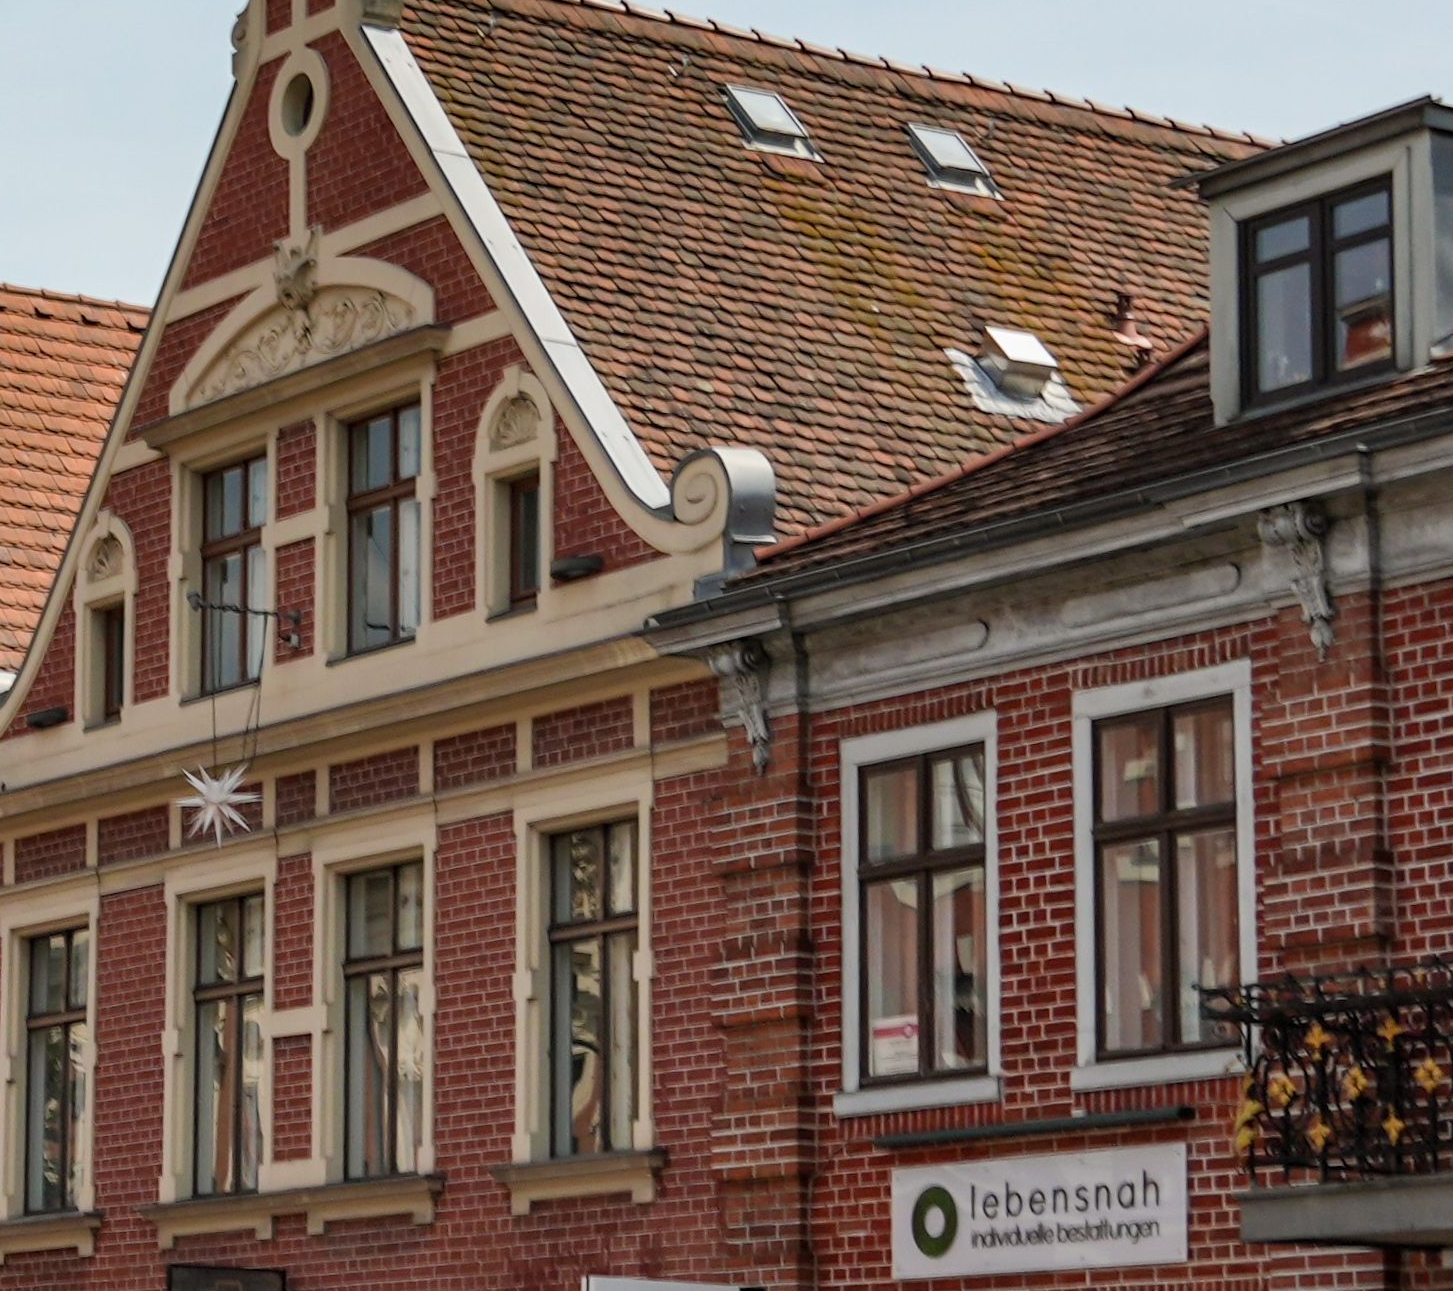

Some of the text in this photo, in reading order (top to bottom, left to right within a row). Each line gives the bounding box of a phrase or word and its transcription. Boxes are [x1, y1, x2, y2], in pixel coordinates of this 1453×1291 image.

[970, 1168, 1160, 1220] lebensnah
[970, 1219, 1160, 1249] individuelle bestattungen
